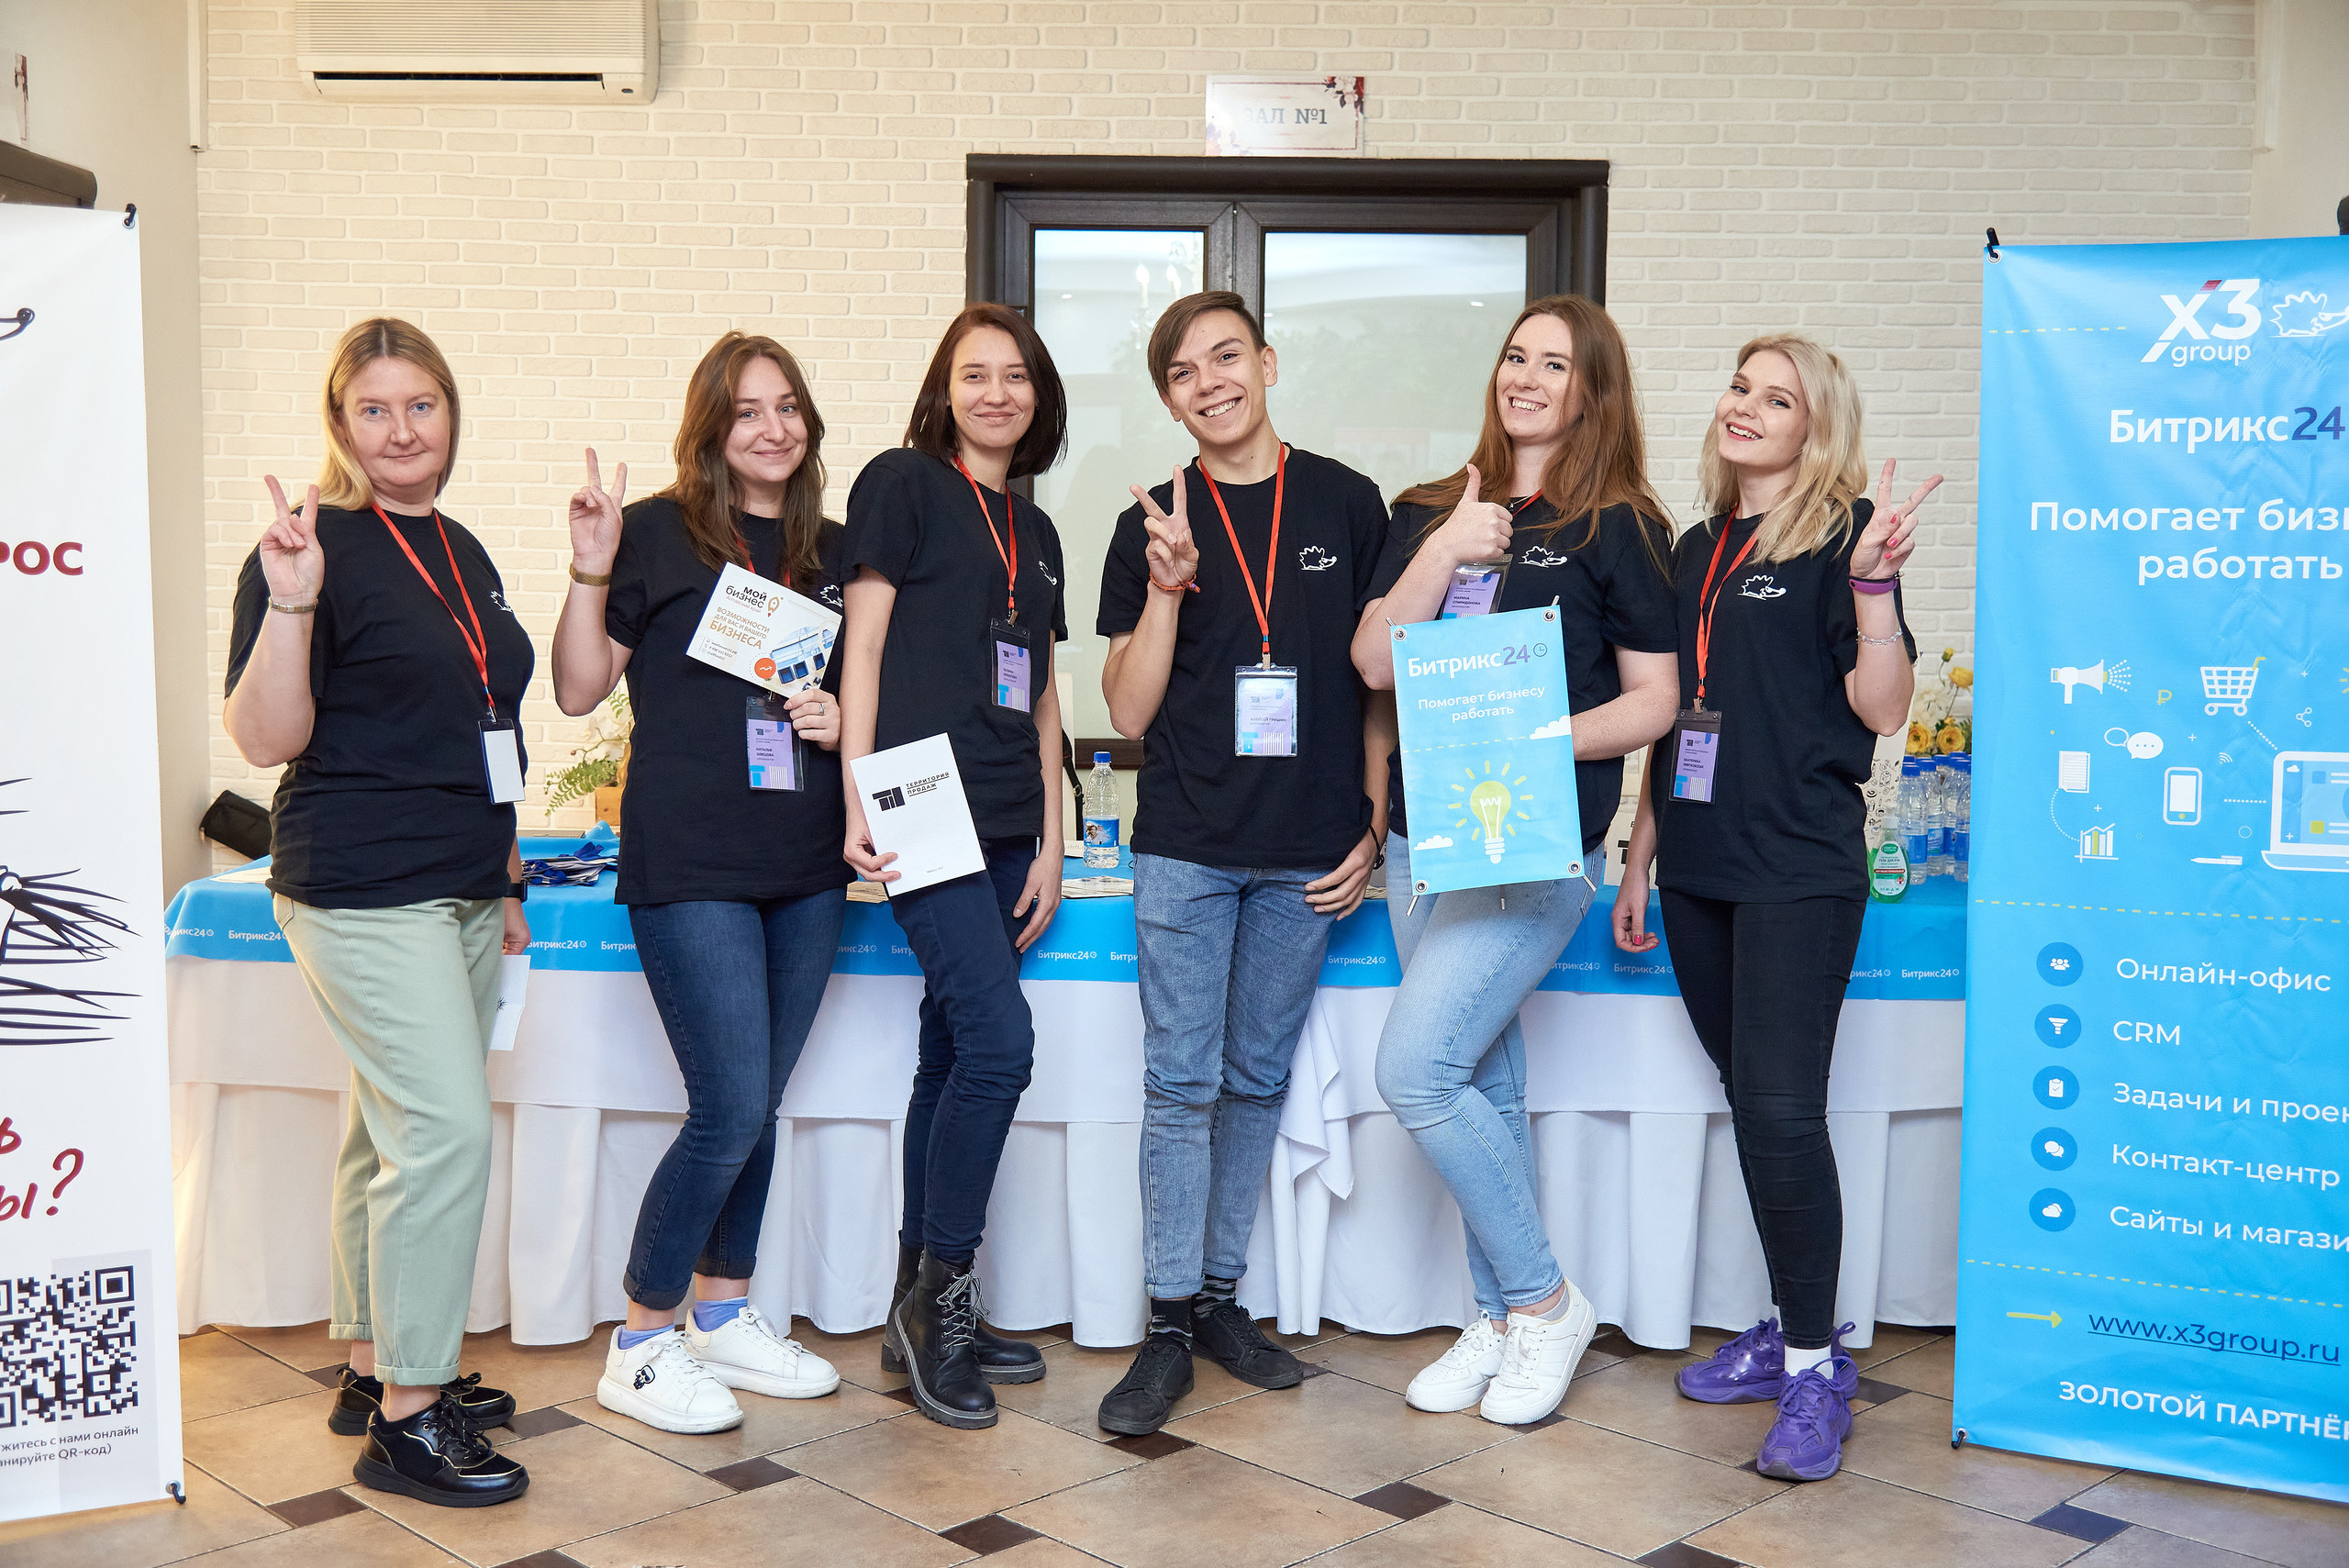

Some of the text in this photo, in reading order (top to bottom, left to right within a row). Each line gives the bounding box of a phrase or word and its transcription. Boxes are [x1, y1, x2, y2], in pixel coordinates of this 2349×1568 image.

[1243, 107, 1328, 125] ЗАЛ №1
[2171, 343, 2251, 367] group
[2110, 406, 2345, 453] Битрикс24
[2031, 502, 2245, 531] Помогает
[2138, 547, 2343, 585] работать
[726, 585, 764, 608] бизнес
[743, 586, 767, 602] мой
[714, 614, 728, 622] ДЛЯ
[728, 618, 740, 628] ВАС
[744, 626, 767, 639] ВАШЕГО
[717, 606, 770, 634] ВОЗМОЖНОСТИ
[709, 620, 762, 650] БИЗНЕСА
[1408, 644, 1531, 678] Битрикс24
[1419, 686, 1545, 709] Помогает бизнесу
[1452, 706, 1514, 723] работать
[906, 772, 950, 788] ТЕРРИТОРИЯ
[907, 783, 937, 795] ПРОДАЖ
[228, 929, 281, 942] Битрикс24
[1038, 950, 1089, 962] Битрикс24
[1328, 955, 1377, 966] Битрикс24
[1614, 963, 1665, 974] Битрикс24
[1901, 969, 1952, 980] Битрикс24
[2116, 958, 2332, 994] Онлайн-офис
[2113, 1020, 2181, 1046] CRM
[2113, 1083, 2221, 1114] Задачи
[2233, 1097, 2250, 1115] и
[2113, 1144, 2341, 1191] Контакт-центр
[2110, 1206, 2203, 1236] Сайты
[2214, 1222, 2232, 1240] и
[2088, 1315, 2340, 1363] www.x3group.ru
[2059, 1381, 2205, 1420] ЗОЛОТОЙ
[1, 1426, 139, 1452] житесь с нами онлайн
[59, 1442, 112, 1462] QR-код)
